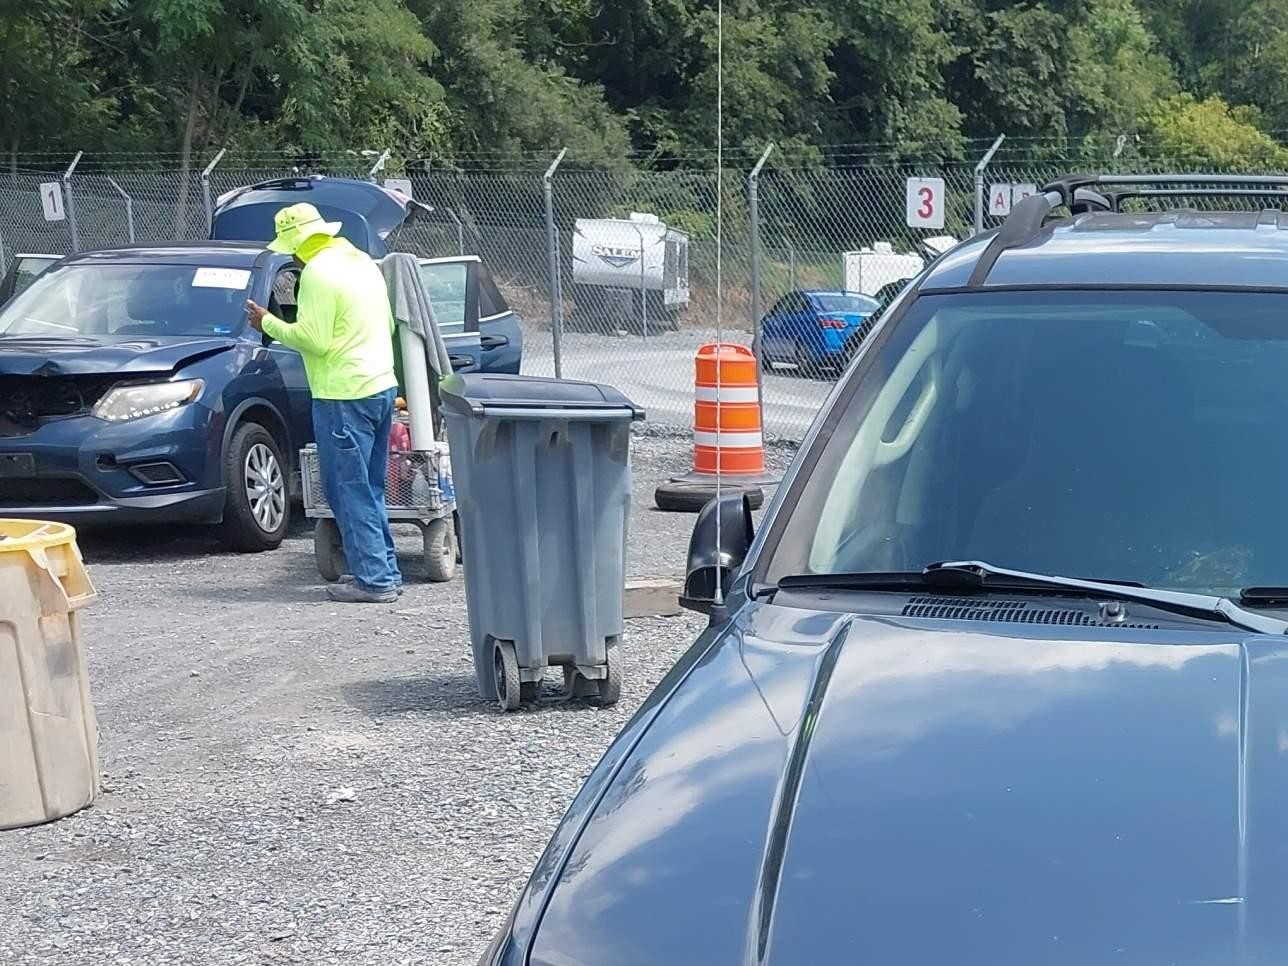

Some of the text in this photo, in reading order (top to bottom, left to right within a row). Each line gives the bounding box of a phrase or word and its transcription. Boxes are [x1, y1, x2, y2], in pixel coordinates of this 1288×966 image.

[48, 190, 57, 213] 1
[917, 187, 934, 219] 3
[994, 192, 1005, 209] A
